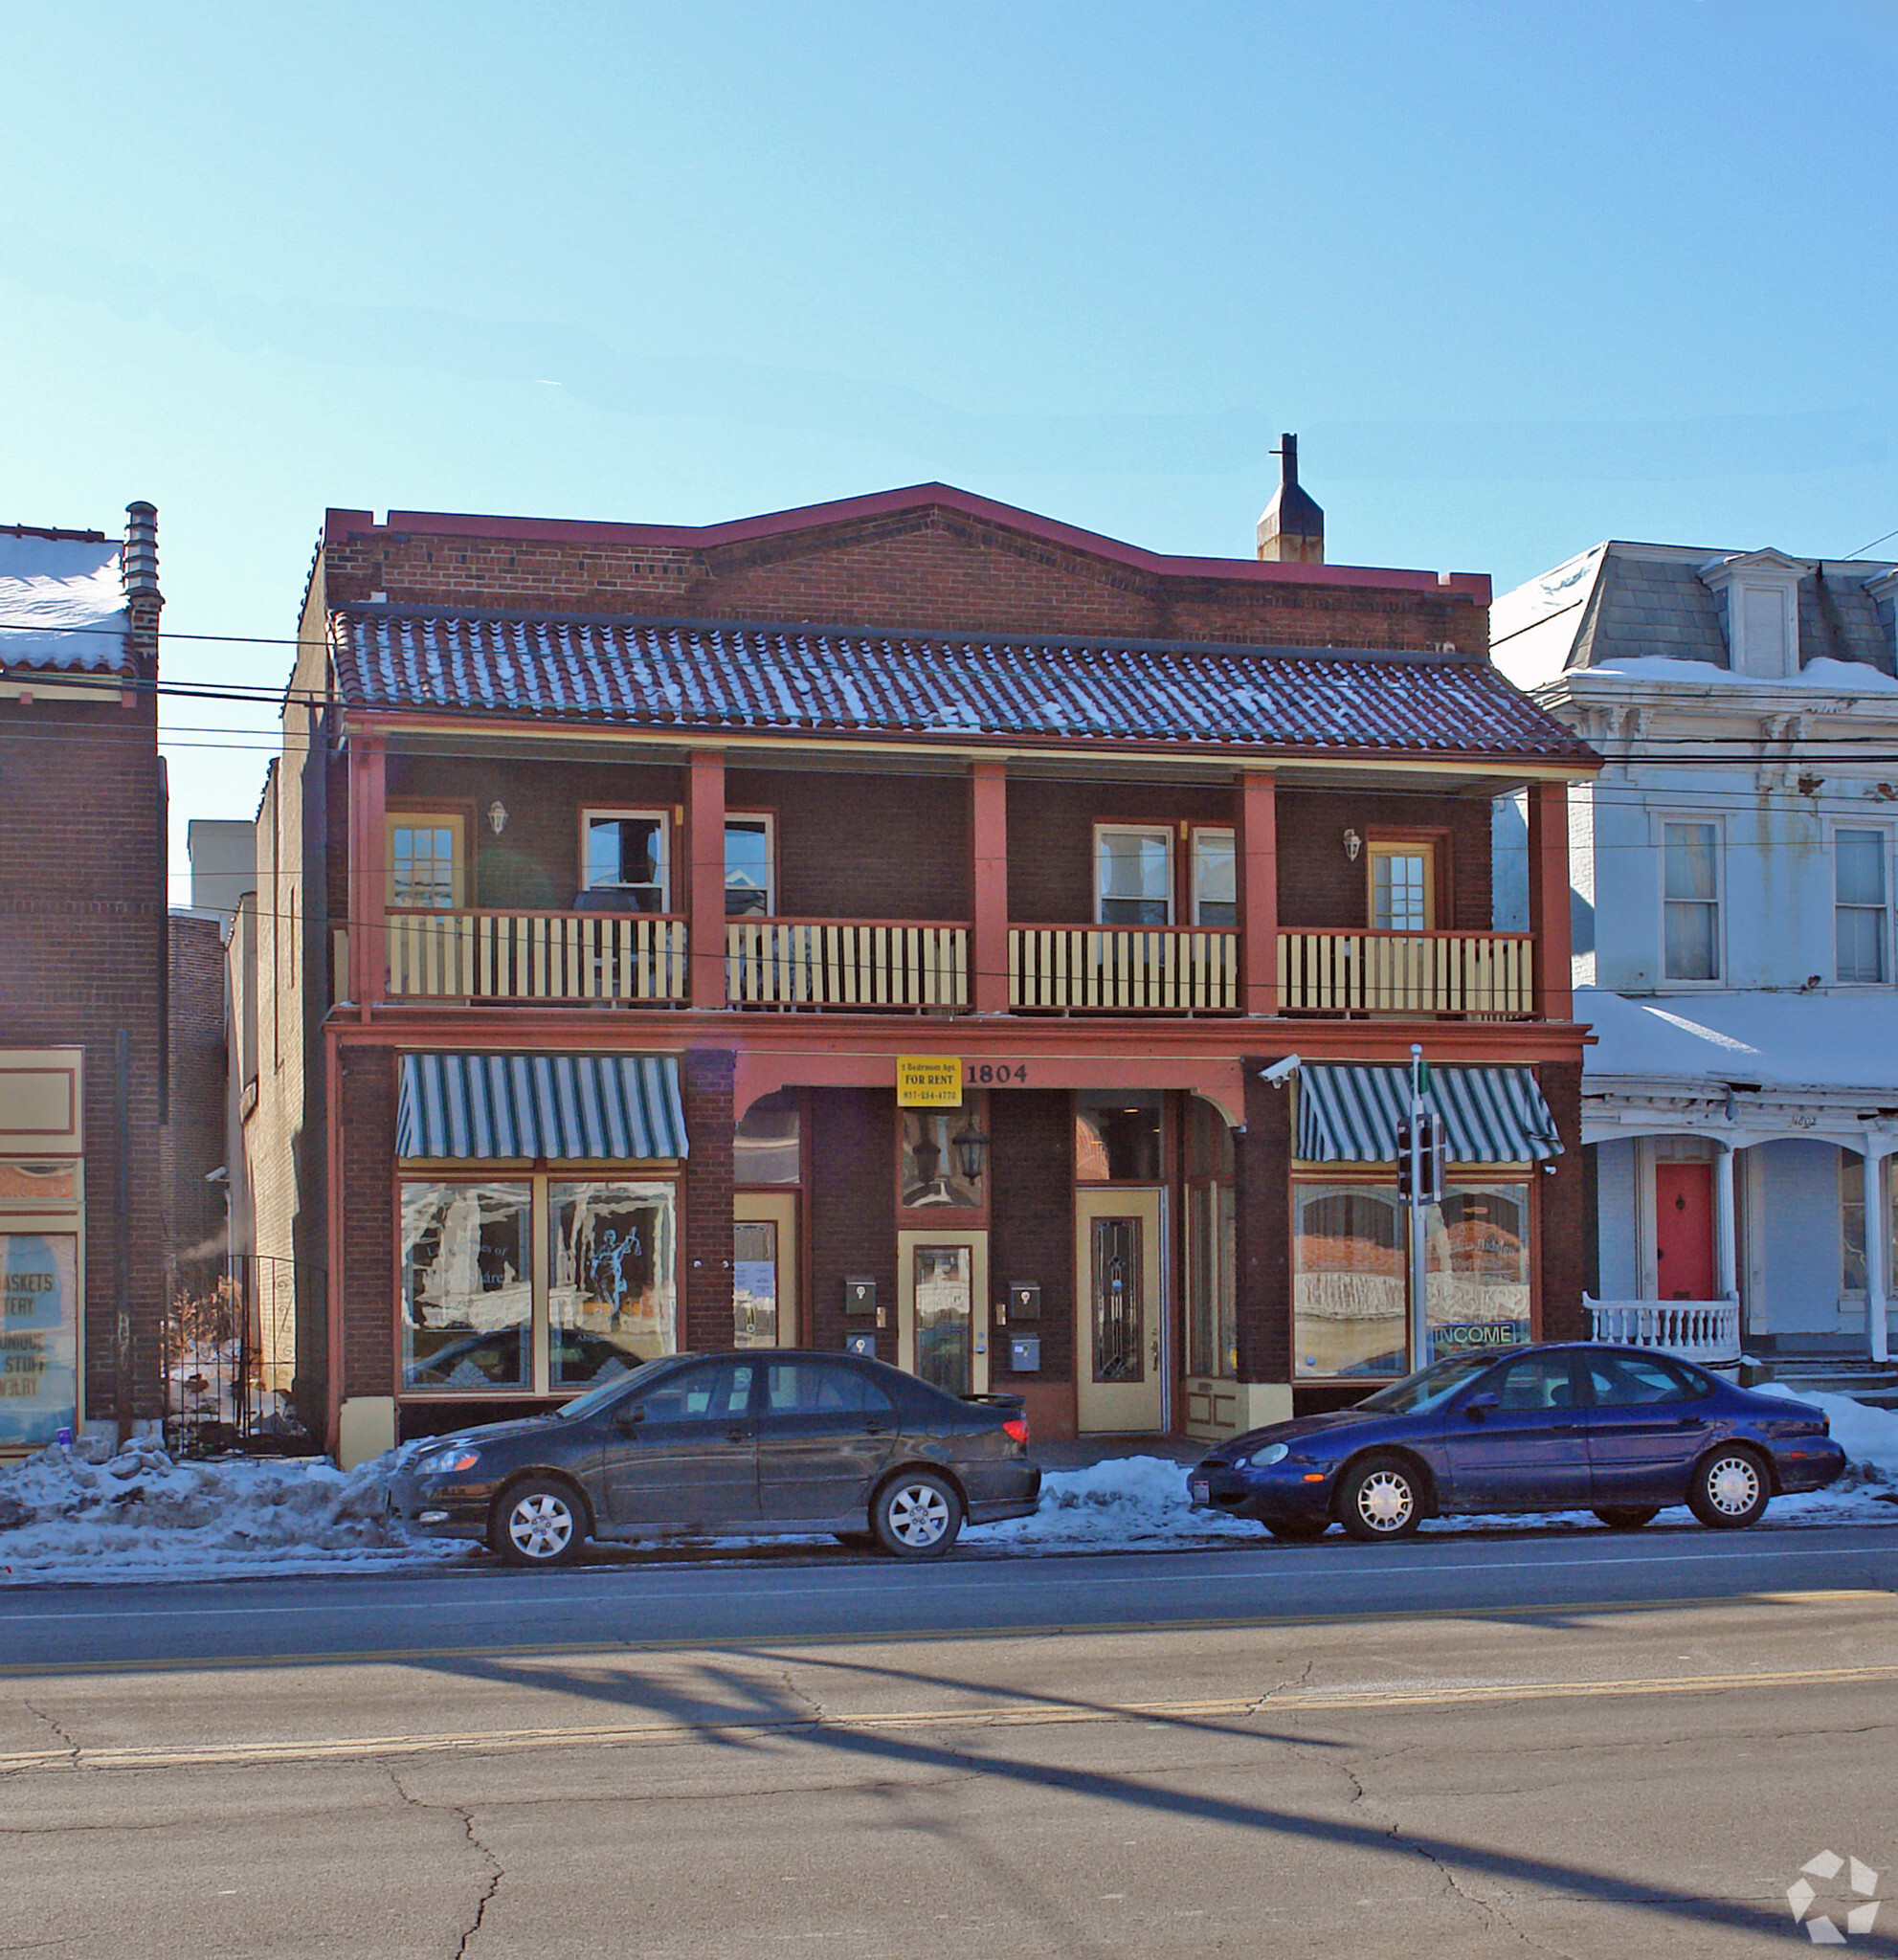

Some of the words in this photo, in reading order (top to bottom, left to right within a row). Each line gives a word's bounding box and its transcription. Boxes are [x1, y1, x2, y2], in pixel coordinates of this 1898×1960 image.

[907, 1062, 941, 1071] Bedroom
[967, 1064, 1027, 1083] 1804
[905, 1074, 926, 1084] FOR
[927, 1075, 953, 1084] RENT
[4, 1273, 54, 1293] ASKETS
[4, 1297, 34, 1316] TERY
[1436, 1325, 1511, 1343] INCOME
[5, 1354, 46, 1374] STUFF
